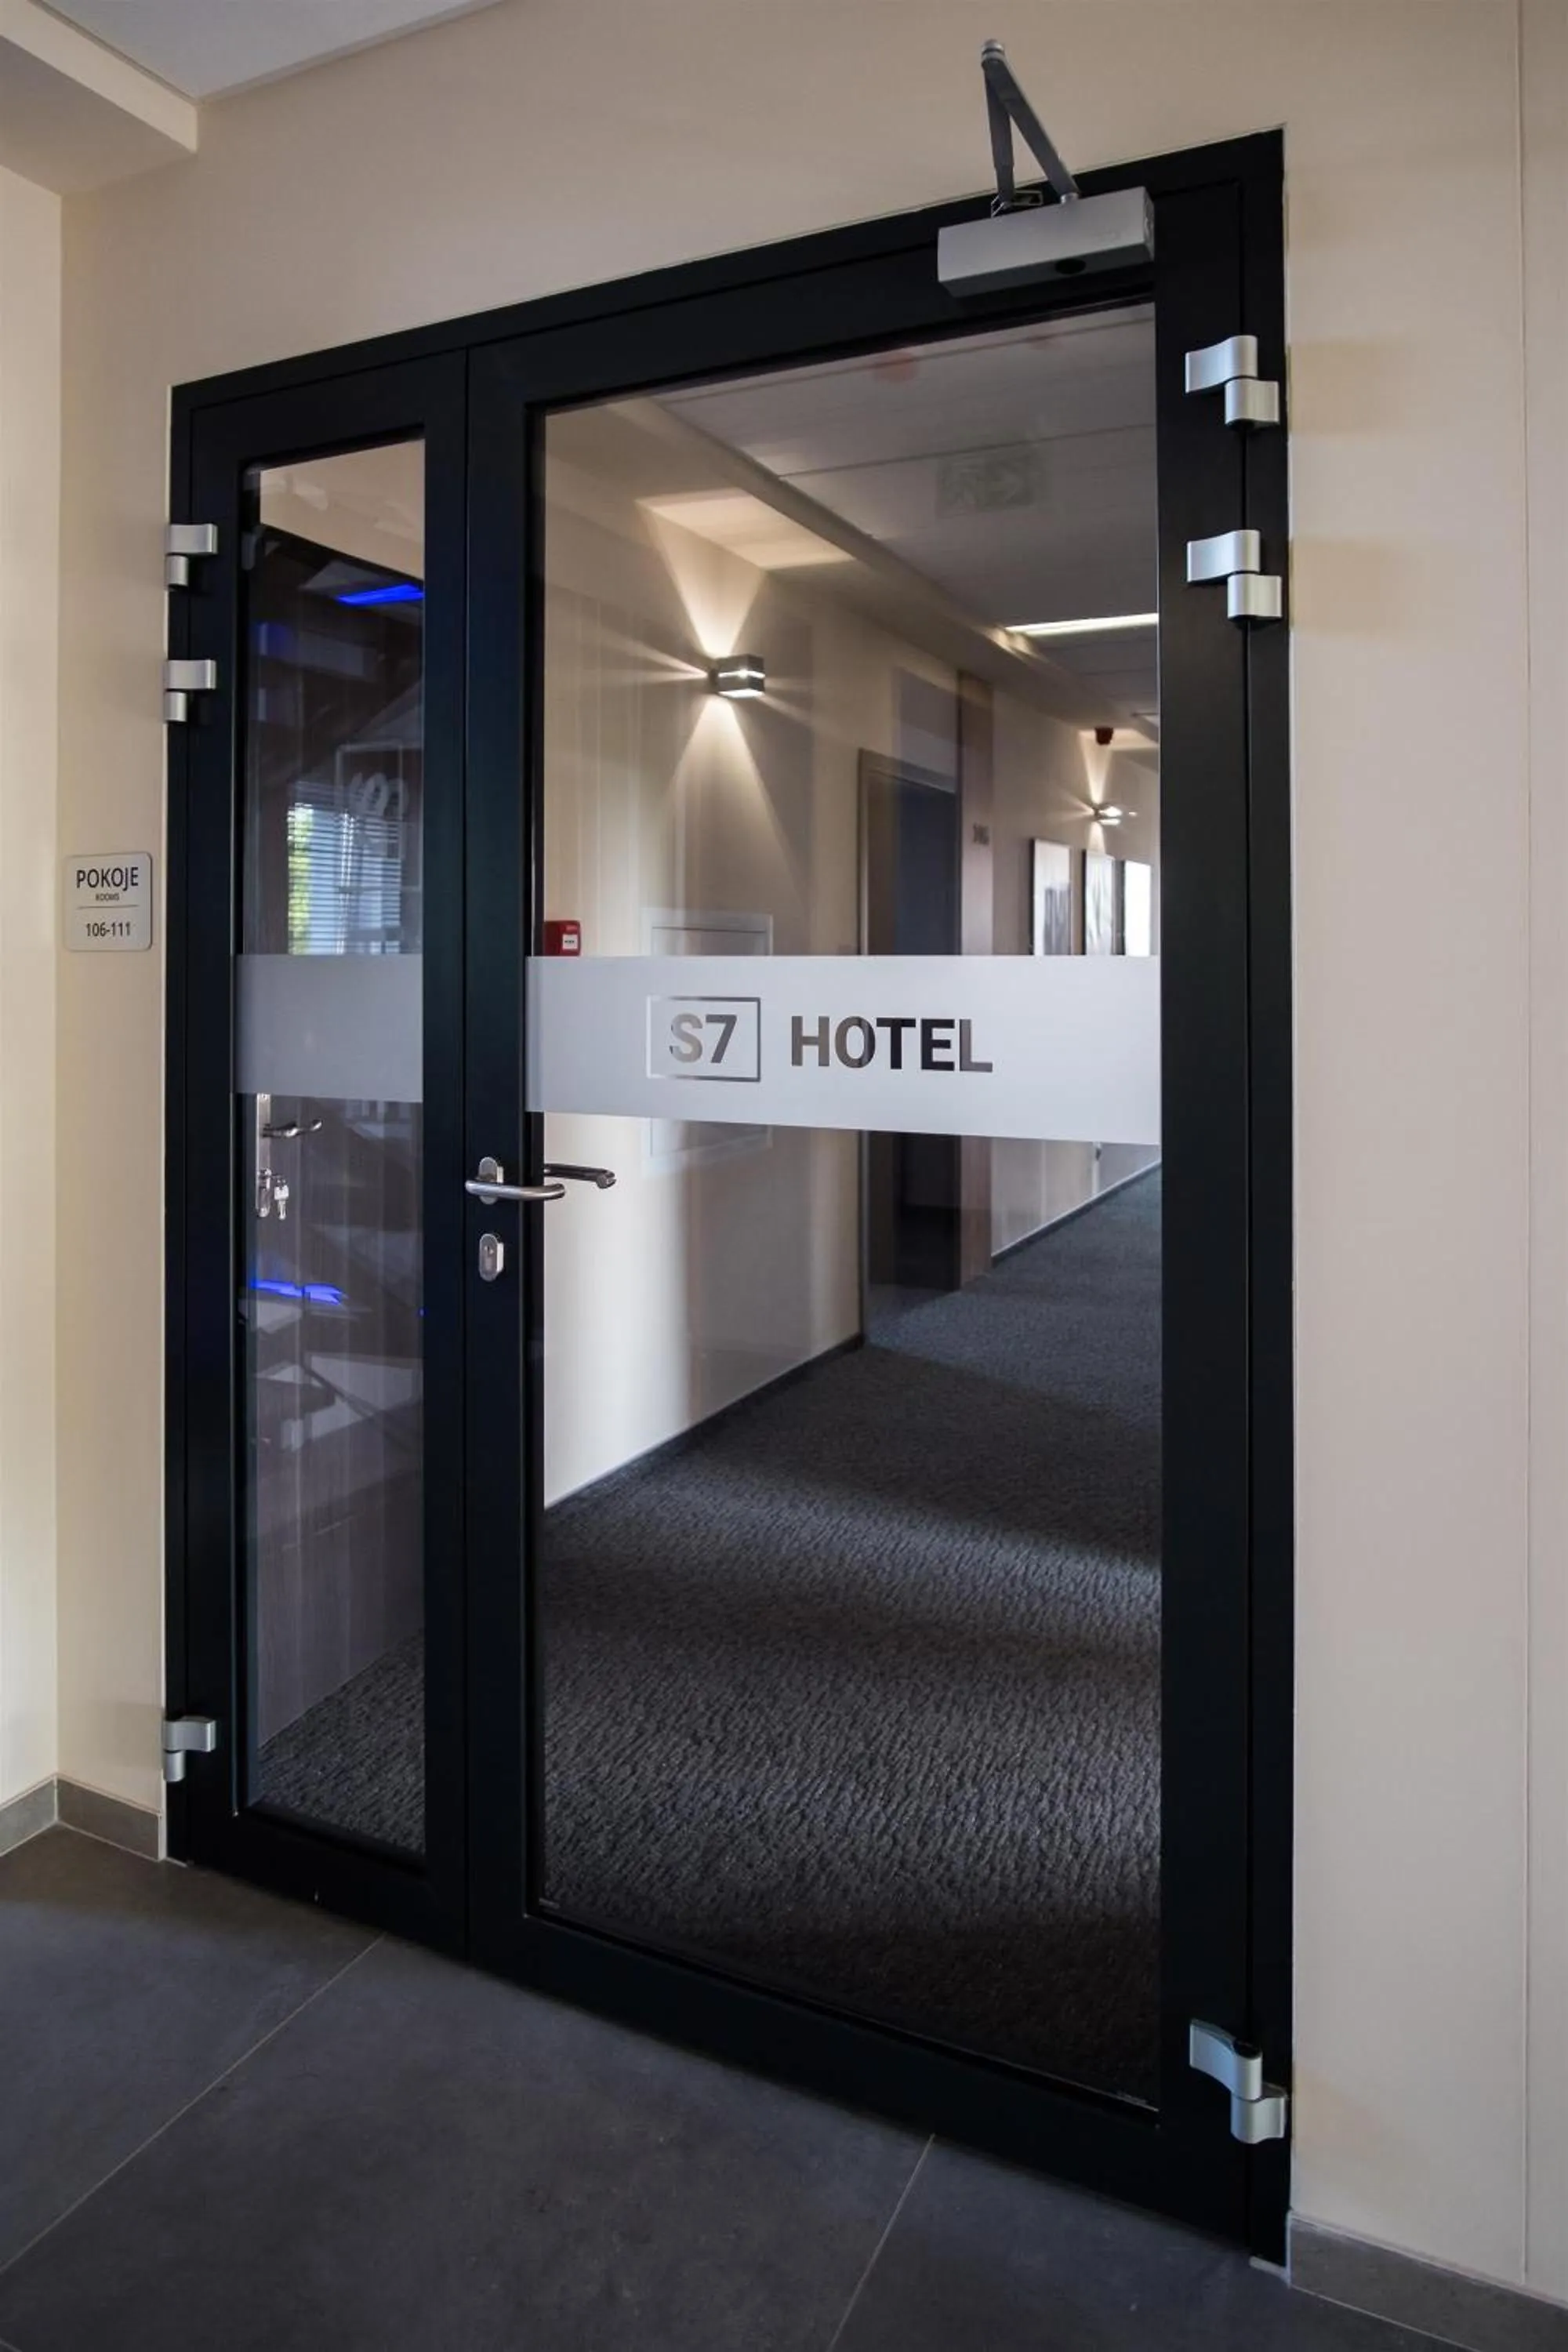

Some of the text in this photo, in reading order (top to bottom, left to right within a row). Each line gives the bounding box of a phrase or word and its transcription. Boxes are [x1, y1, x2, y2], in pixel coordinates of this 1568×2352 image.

[76, 866, 139, 891] POKOJE
[85, 921, 132, 938] 106-111
[669, 1012, 993, 1073] S7 HOTEL
